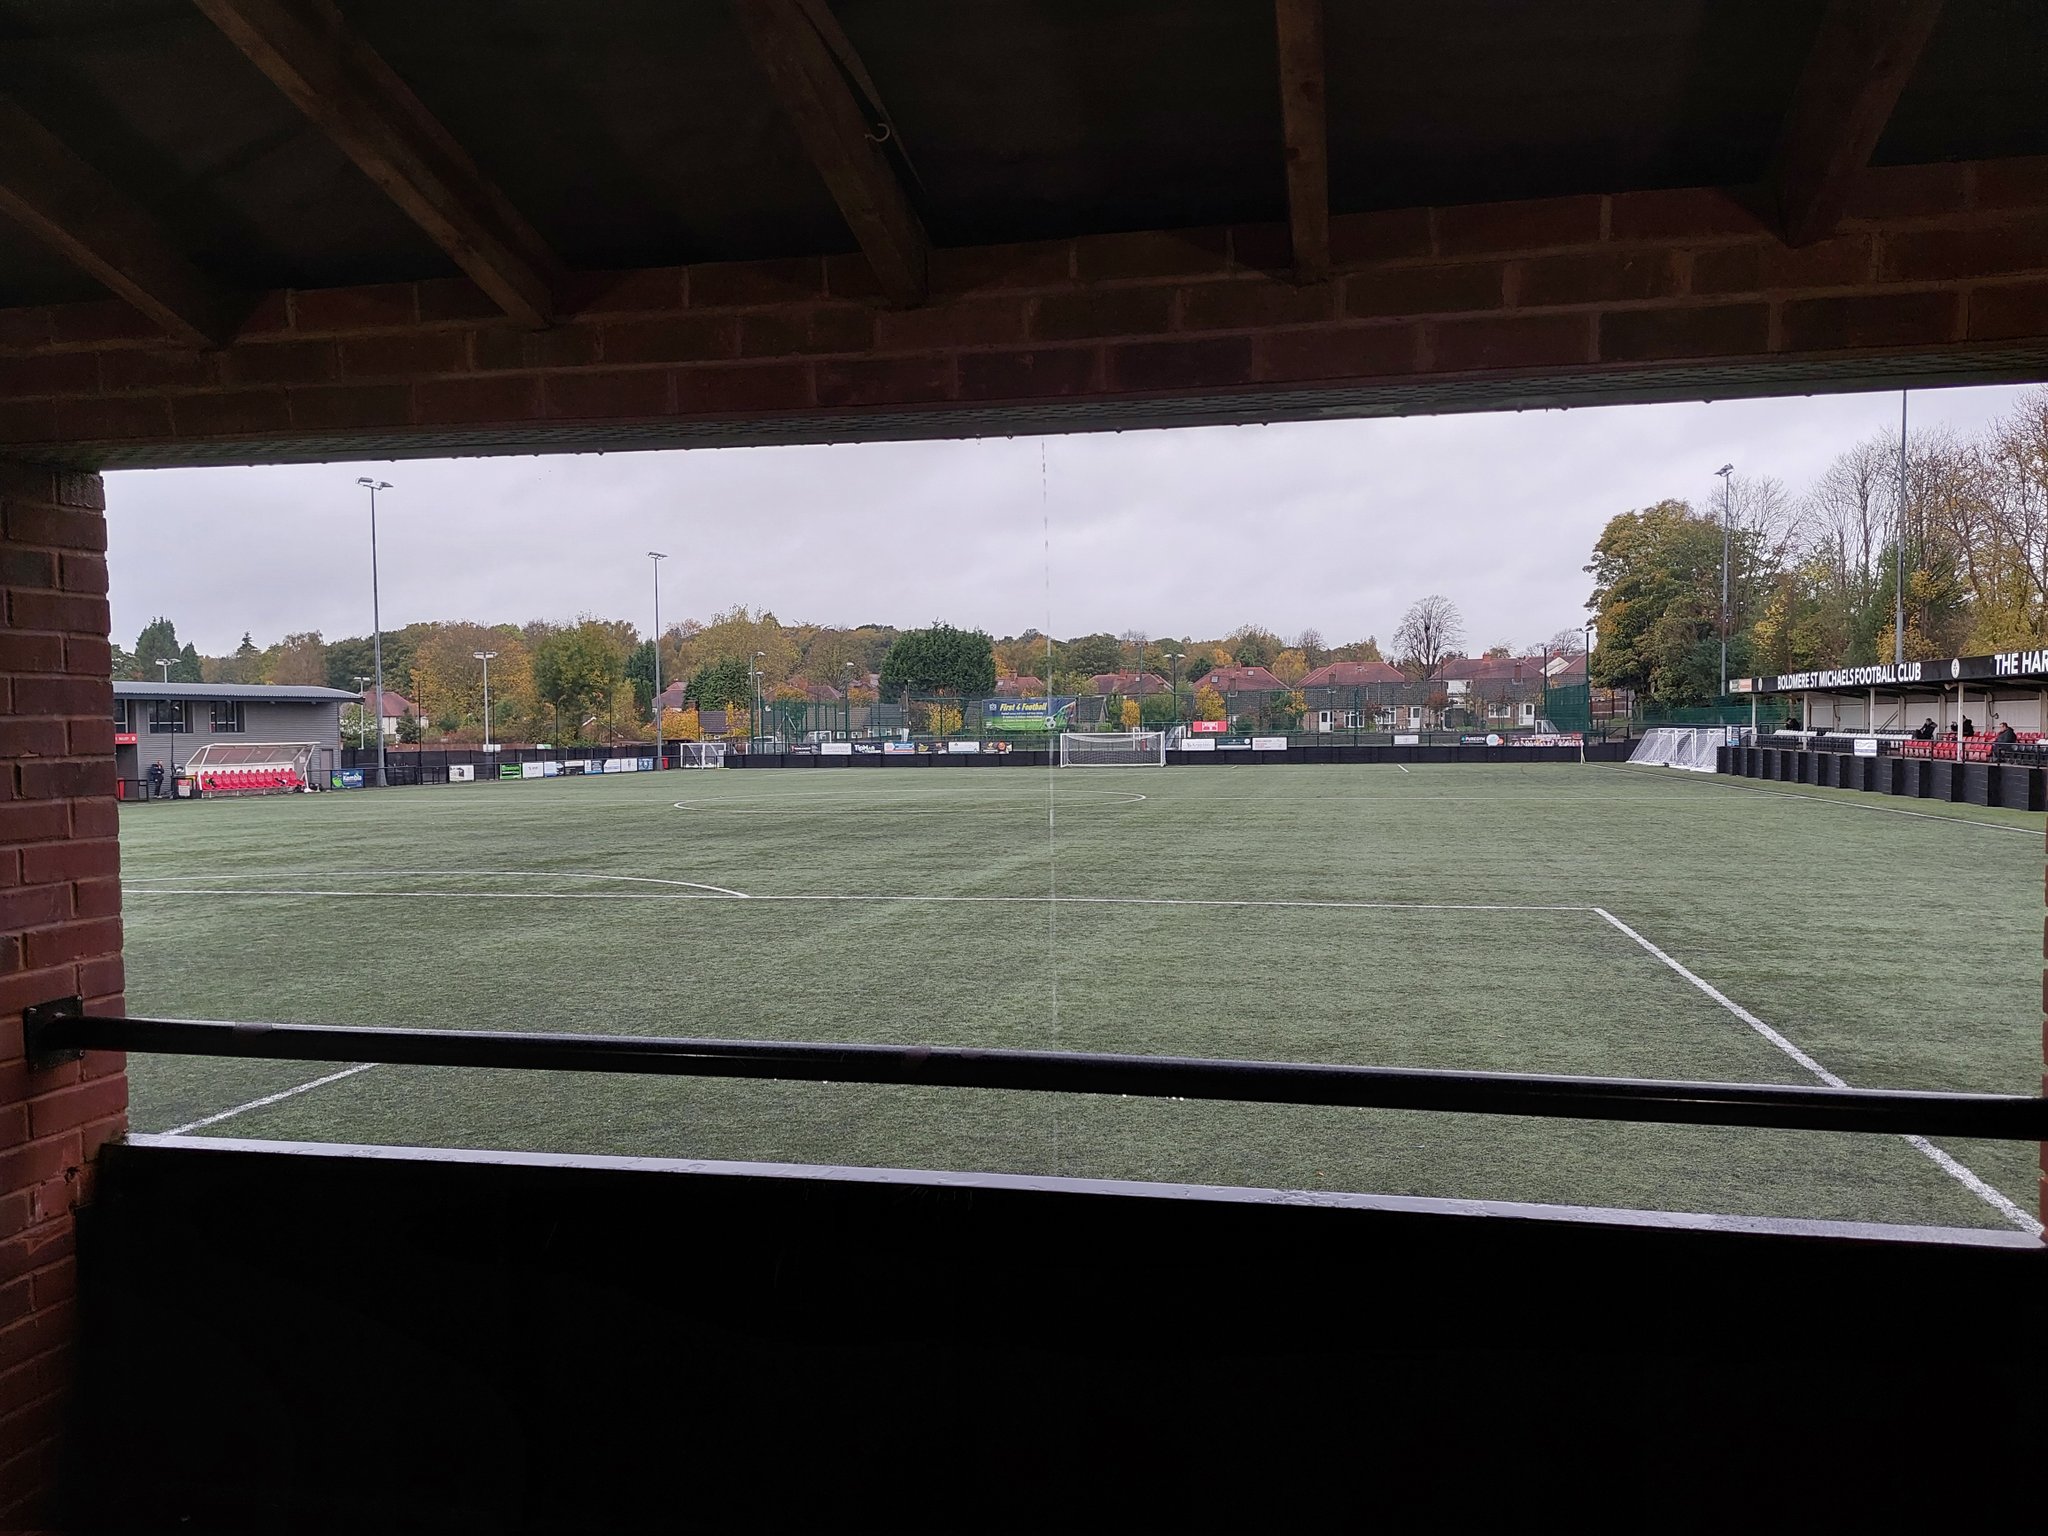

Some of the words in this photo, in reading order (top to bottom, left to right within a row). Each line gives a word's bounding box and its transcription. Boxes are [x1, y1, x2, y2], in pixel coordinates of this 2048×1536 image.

[1994, 653, 2019, 675] THE
[2022, 649, 2048, 673] HAR
[1777, 672, 1810, 690] BOLDMERE
[1809, 671, 1819, 688] ST
[1818, 667, 1855, 687] MICHAELS
[1855, 665, 1897, 685] FOOTBALL
[1898, 662, 1922, 682] CLUB
[999, 703, 1016, 711] First
[1021, 702, 1048, 711] Football
